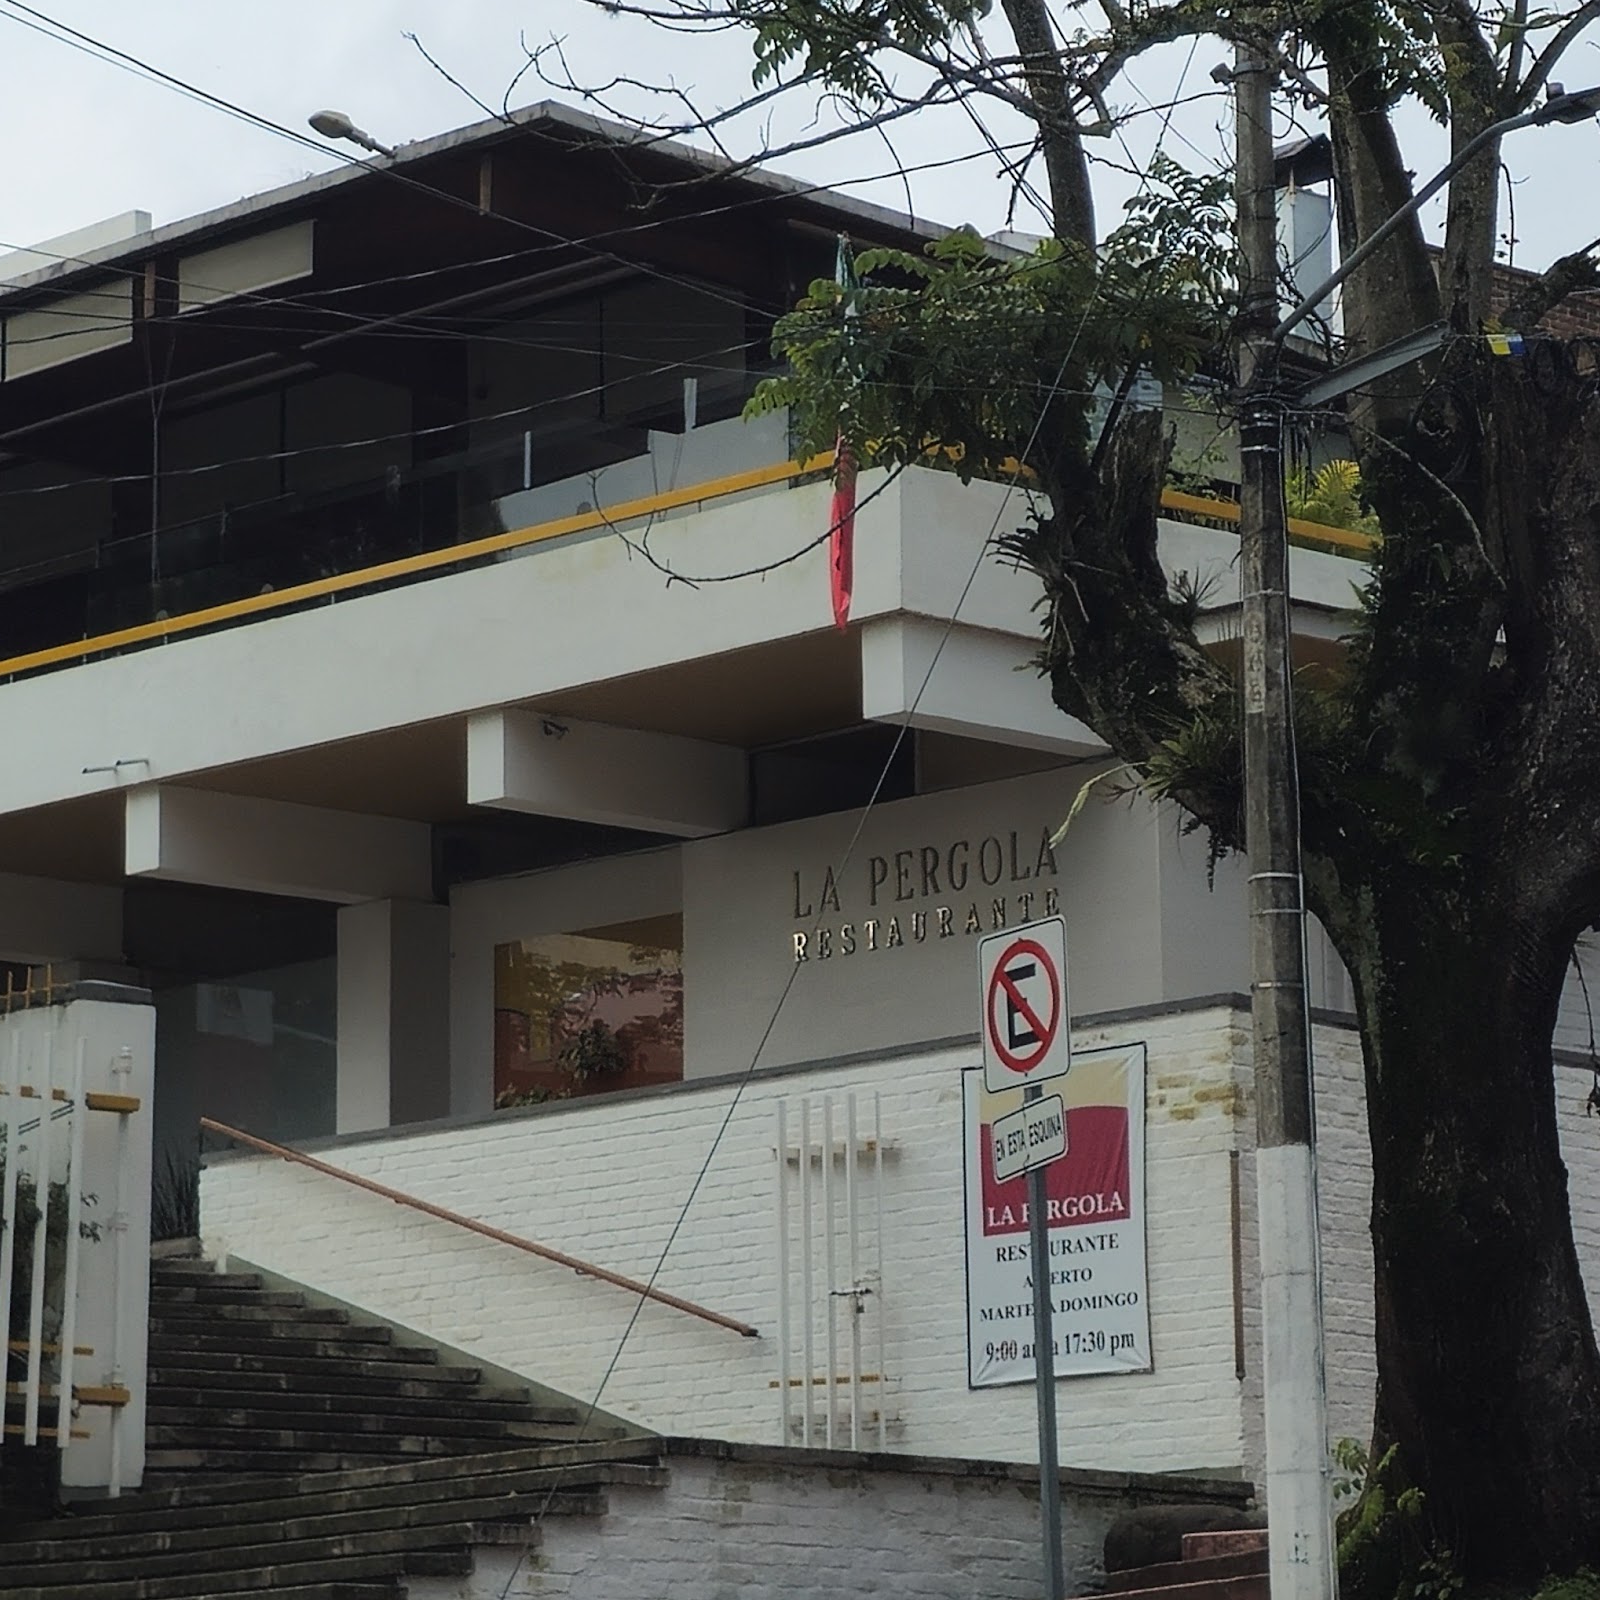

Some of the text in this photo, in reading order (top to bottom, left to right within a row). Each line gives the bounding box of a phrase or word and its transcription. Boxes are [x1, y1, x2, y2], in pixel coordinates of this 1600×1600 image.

[793, 826, 1058, 919] LA PERGOLA
[792, 887, 1060, 963] RESTAURANTE
[996, 1113, 1063, 1162] EN ESTA ESQUINA
[987, 1191, 1125, 1227] LA PRGOLA
[996, 1233, 1119, 1263] RESURANTE
[1023, 1267, 1093, 1289] AERTO
[980, 1303, 1035, 1322] MARTE
[1060, 1291, 1139, 1313] DOMINGO
[985, 1339, 1018, 1365] 9:00
[1064, 1330, 1105, 1355] 17:30
[1109, 1332, 1135, 1357] pm
